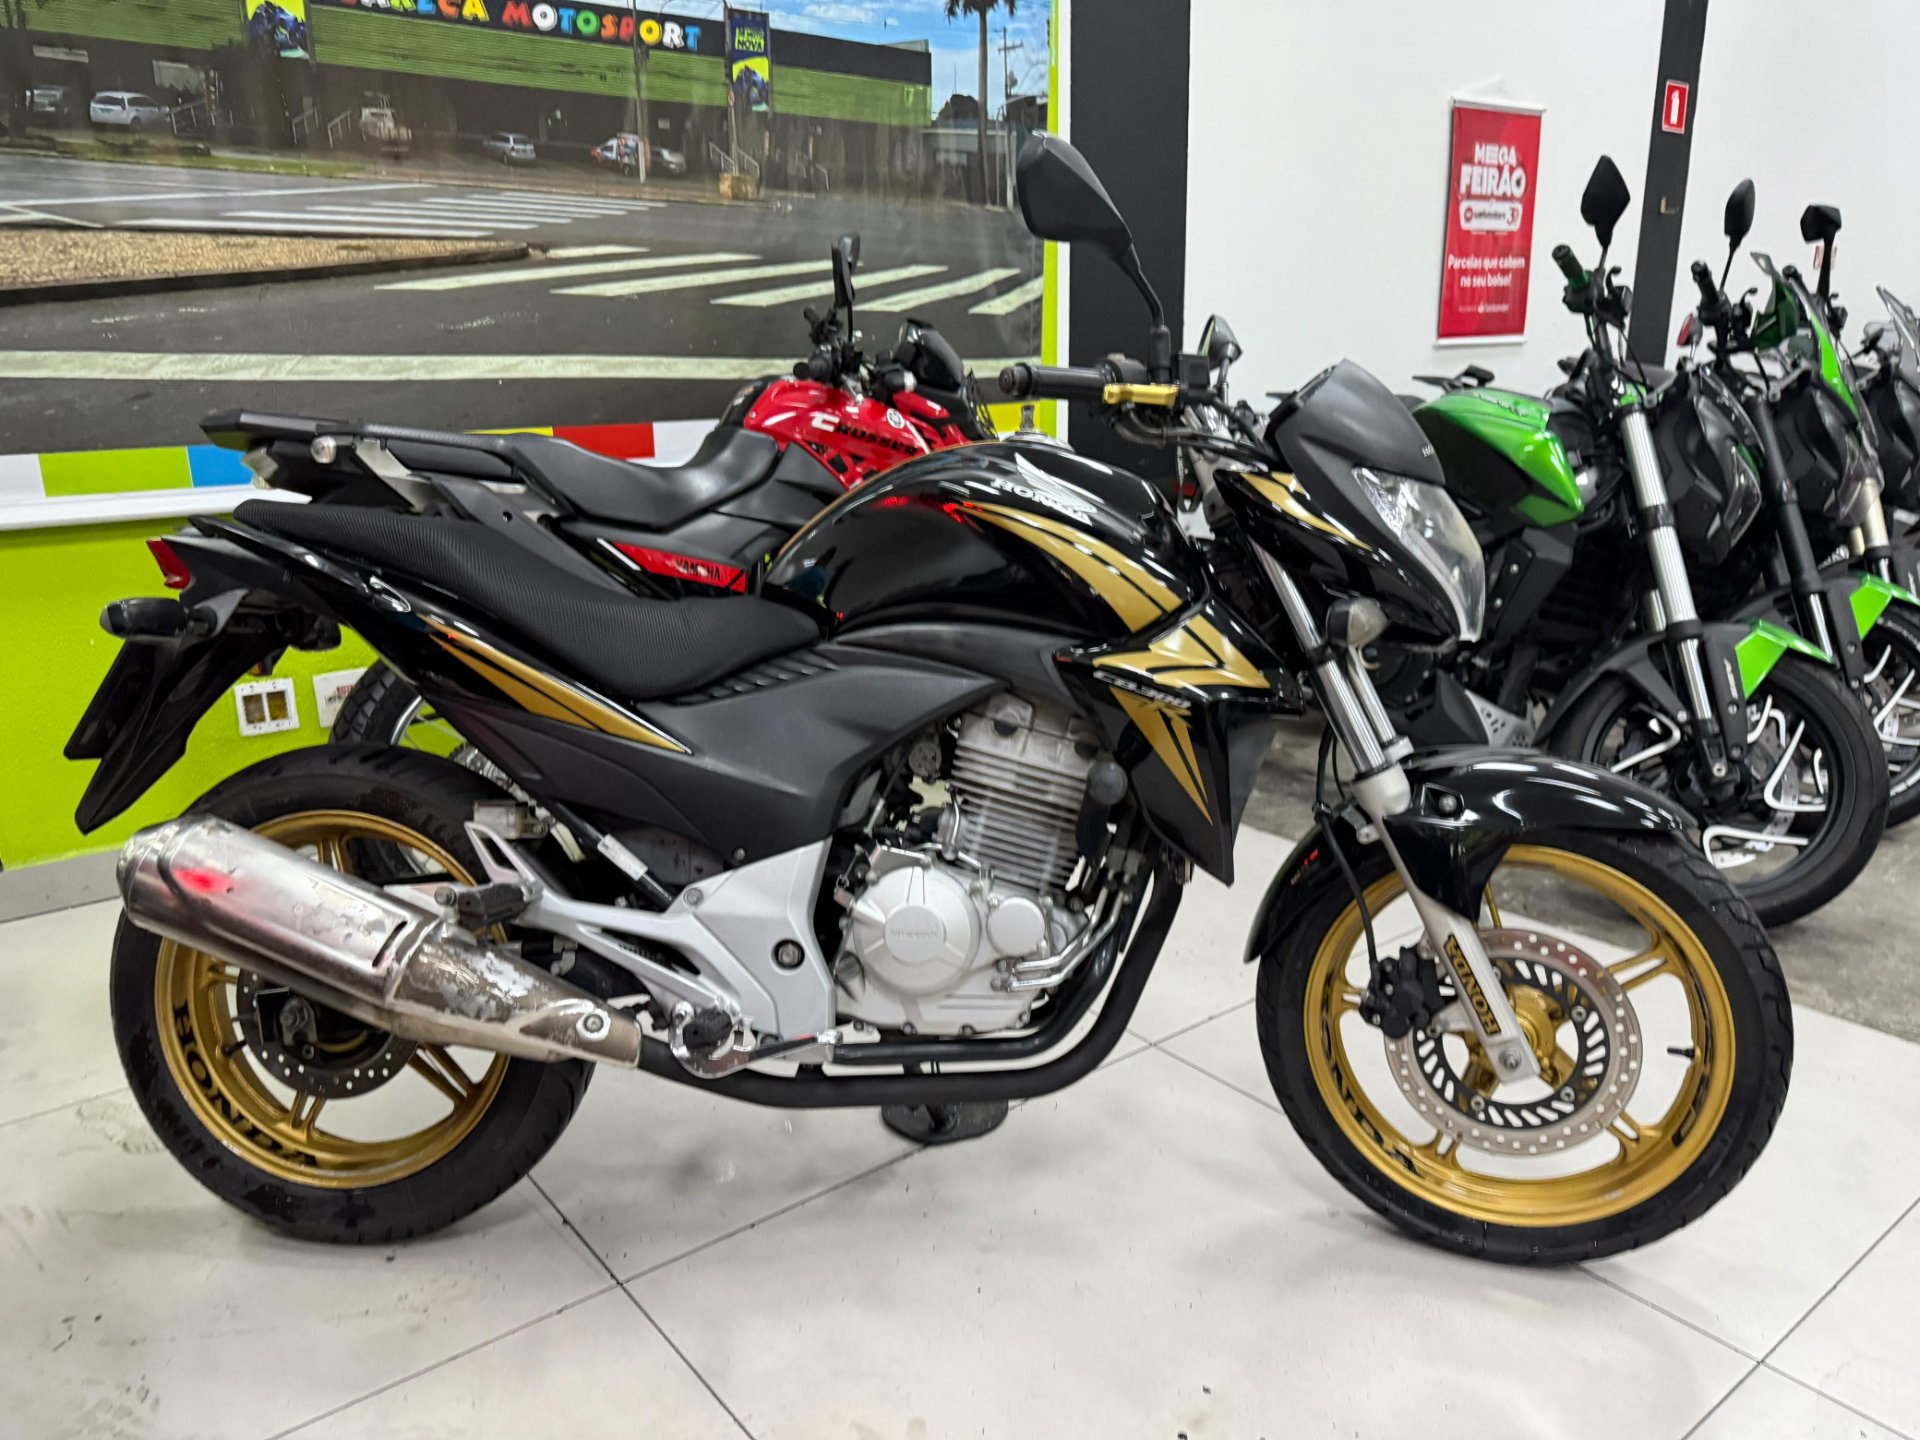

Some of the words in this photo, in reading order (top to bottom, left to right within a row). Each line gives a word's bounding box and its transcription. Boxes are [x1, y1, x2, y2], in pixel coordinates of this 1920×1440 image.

[341, 0, 489, 21] RECA
[502, 1, 701, 51] MOTOSPORT
[1474, 142, 1517, 168] MEGA
[1460, 162, 1526, 199] FEIRÃO
[1448, 253, 1482, 270] Parcelas
[1483, 256, 1498, 272] que
[1472, 275, 1487, 288] seu
[809, 410, 918, 457] CROSSER
[990, 477, 1093, 526] HONDA
[1443, 932, 1502, 1036] HONDA
[172, 999, 318, 1167] HONDA
